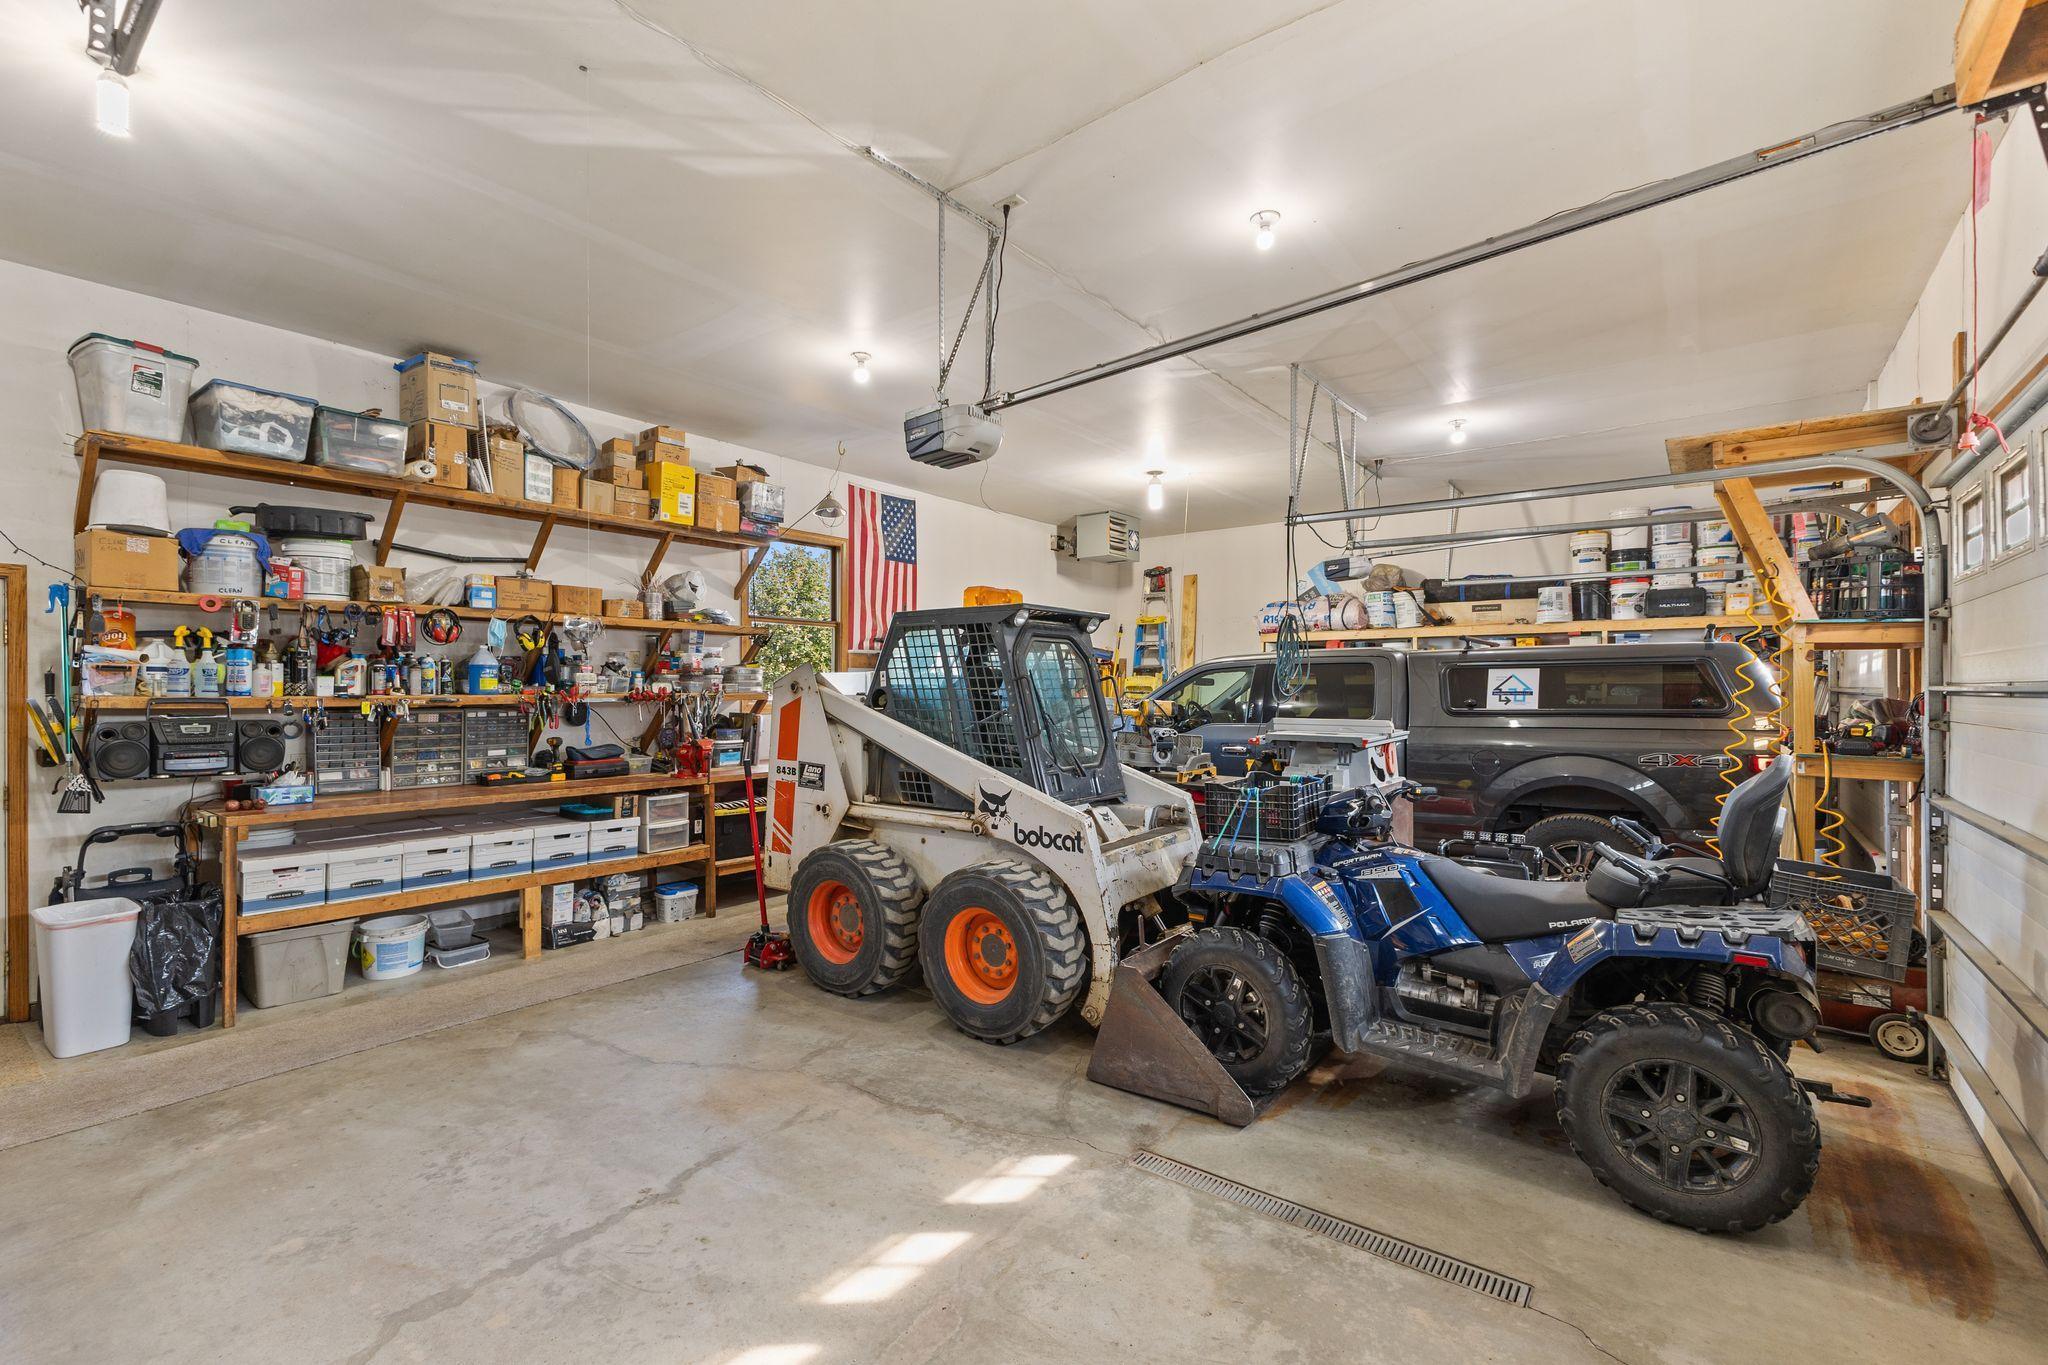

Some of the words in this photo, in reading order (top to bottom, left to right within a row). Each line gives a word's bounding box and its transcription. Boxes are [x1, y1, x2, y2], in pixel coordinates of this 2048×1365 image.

[219, 537, 253, 547] CLEAN
[218, 587, 243, 595] CLEAN
[776, 765, 797, 776] 843B
[1014, 822, 1084, 854] bobcat
[1332, 852, 1382, 868] SPORTSMAN
[1361, 863, 1400, 877] 850
[1548, 916, 1597, 929] POLARIS
